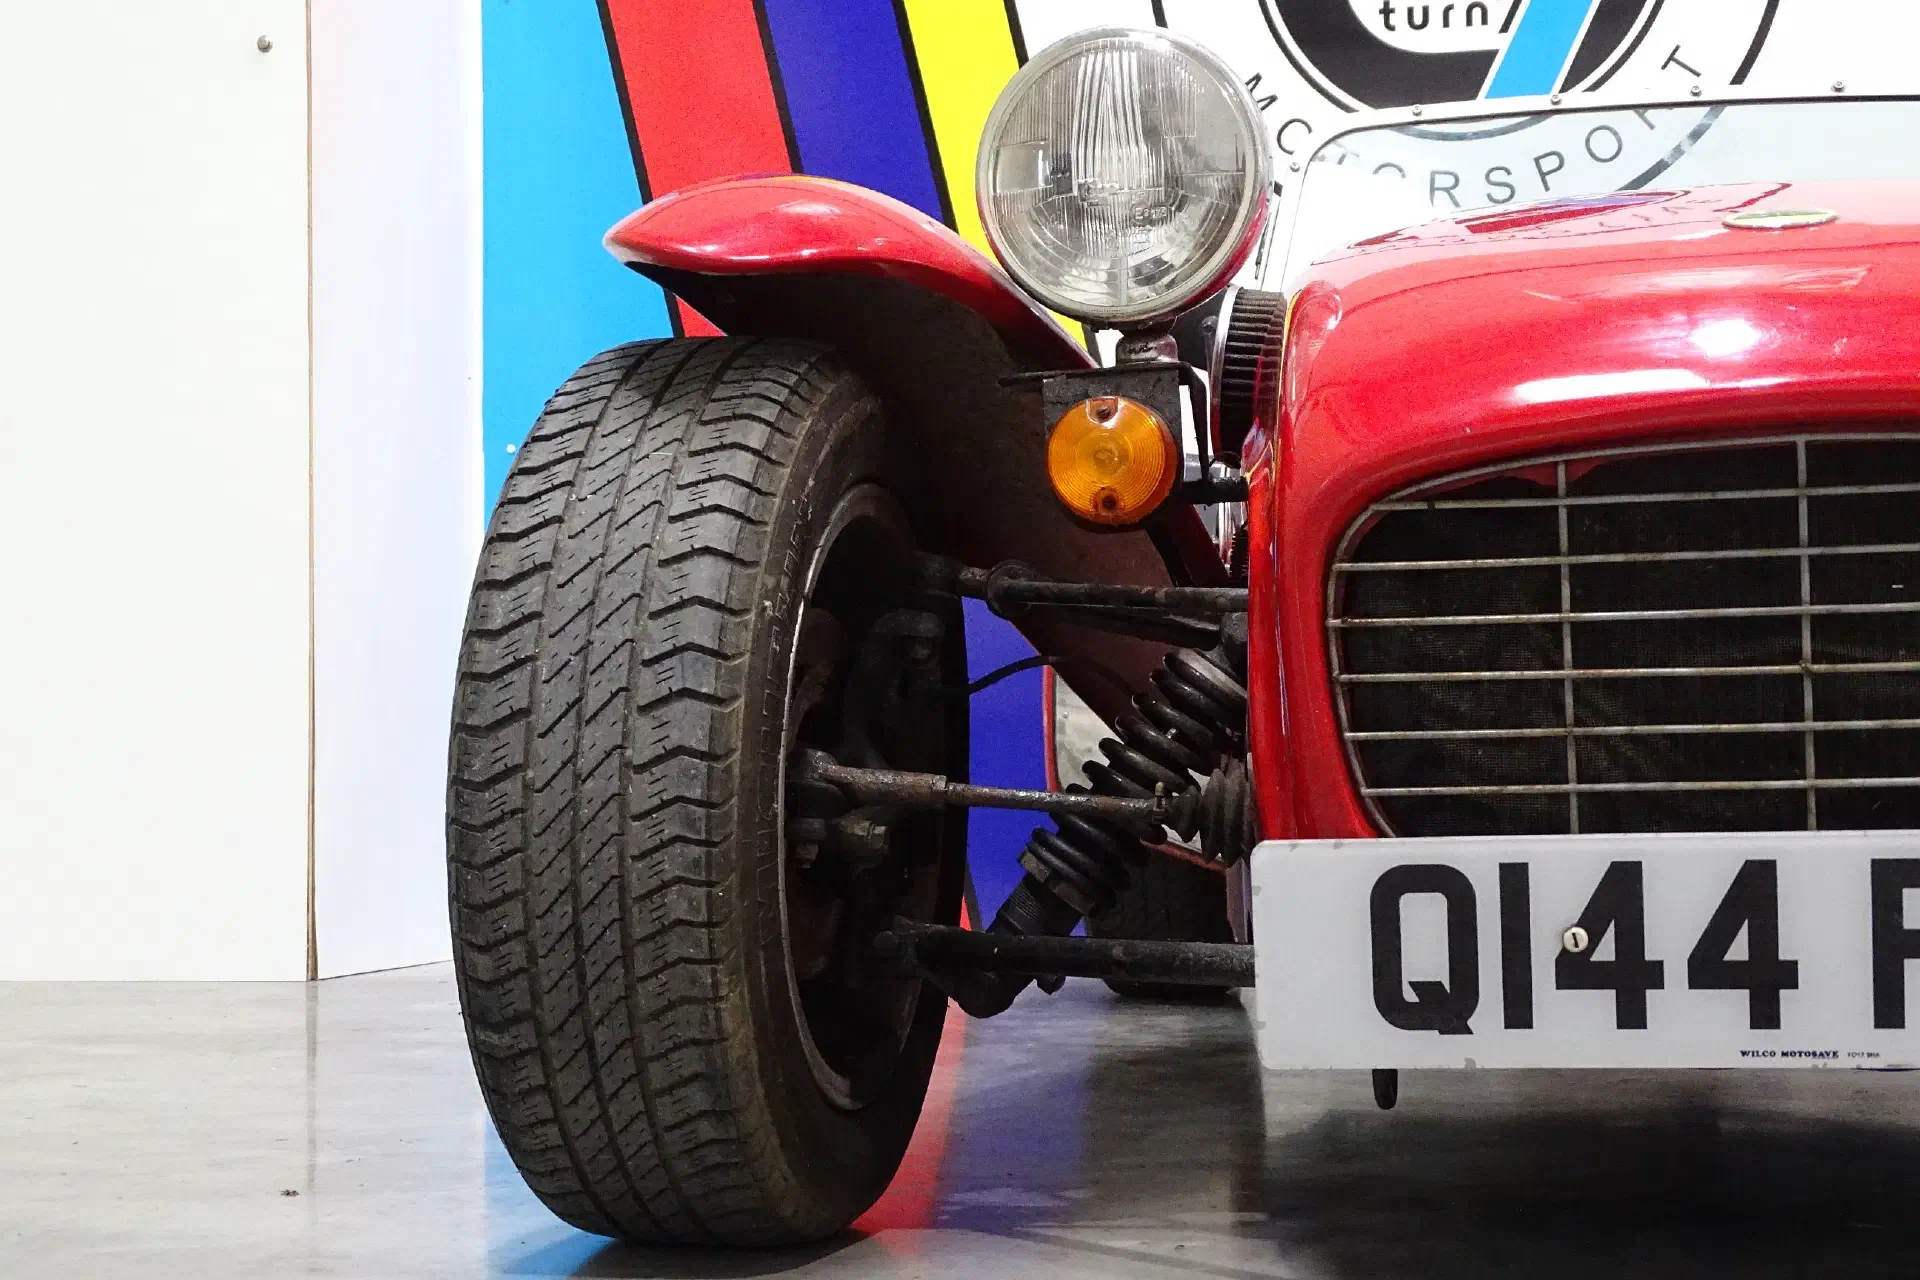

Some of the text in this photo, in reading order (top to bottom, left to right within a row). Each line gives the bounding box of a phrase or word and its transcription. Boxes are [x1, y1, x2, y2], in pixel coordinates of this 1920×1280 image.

[1379, 0, 1489, 32] turn
[1369, 859, 1799, 1035] Q144
[1740, 1050, 1777, 1058] WILCO
[1780, 1050, 1840, 1060] MOTOSAVE
